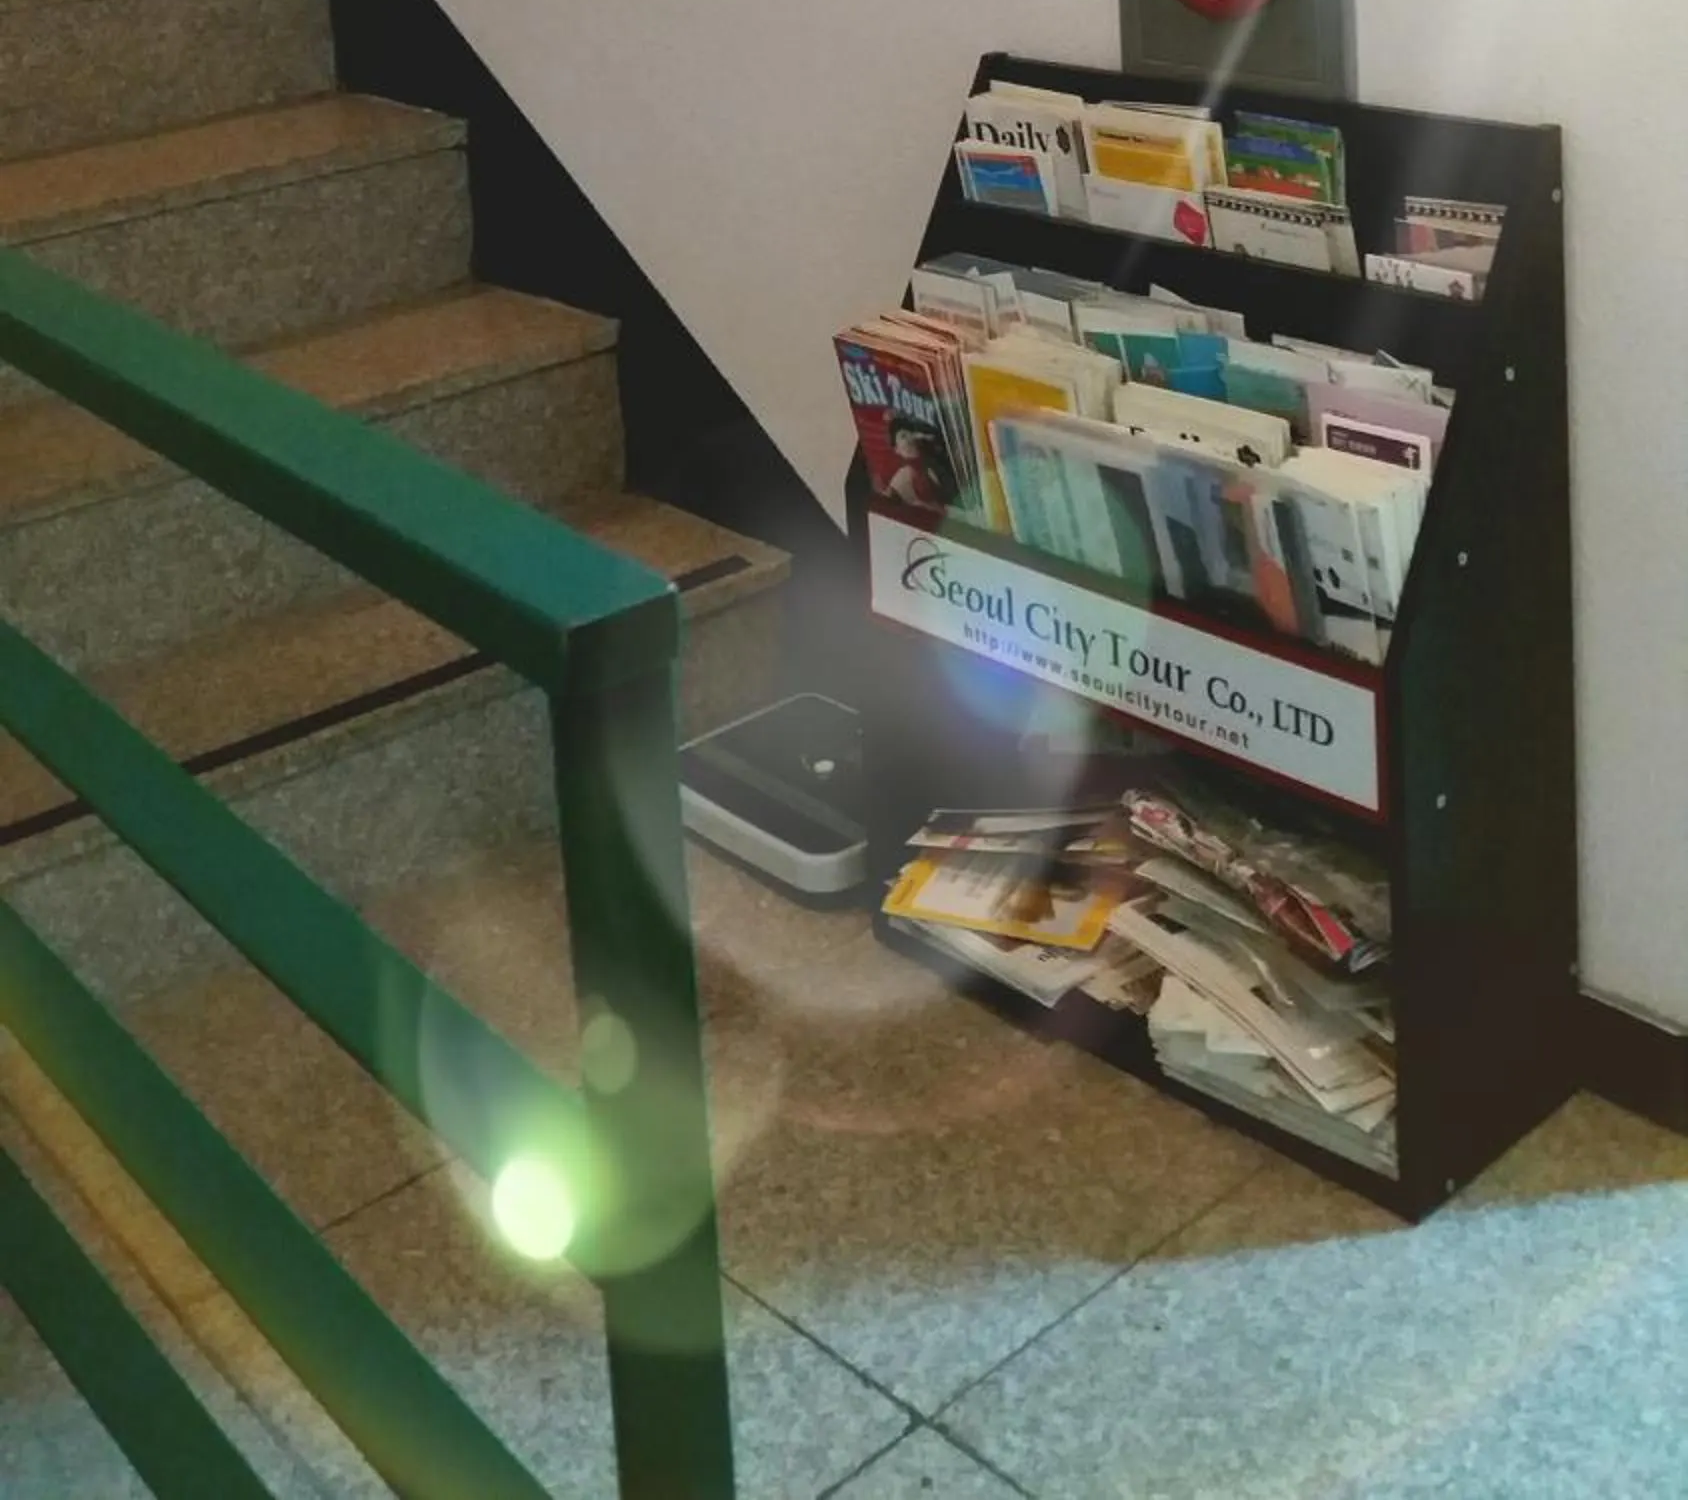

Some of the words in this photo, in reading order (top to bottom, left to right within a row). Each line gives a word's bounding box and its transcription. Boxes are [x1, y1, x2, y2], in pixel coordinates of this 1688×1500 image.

[973, 121, 1051, 152] Daily
[843, 361, 888, 405] Ski
[887, 372, 938, 427] Tour
[929, 561, 1015, 627] Seoul
[1025, 602, 1096, 666] City
[1102, 629, 1192, 693] Tour
[1207, 676, 1263, 727] Co.,
[1271, 700, 1334, 747] LTD
[964, 622, 1251, 750] http://www.seoulcitytour.net
